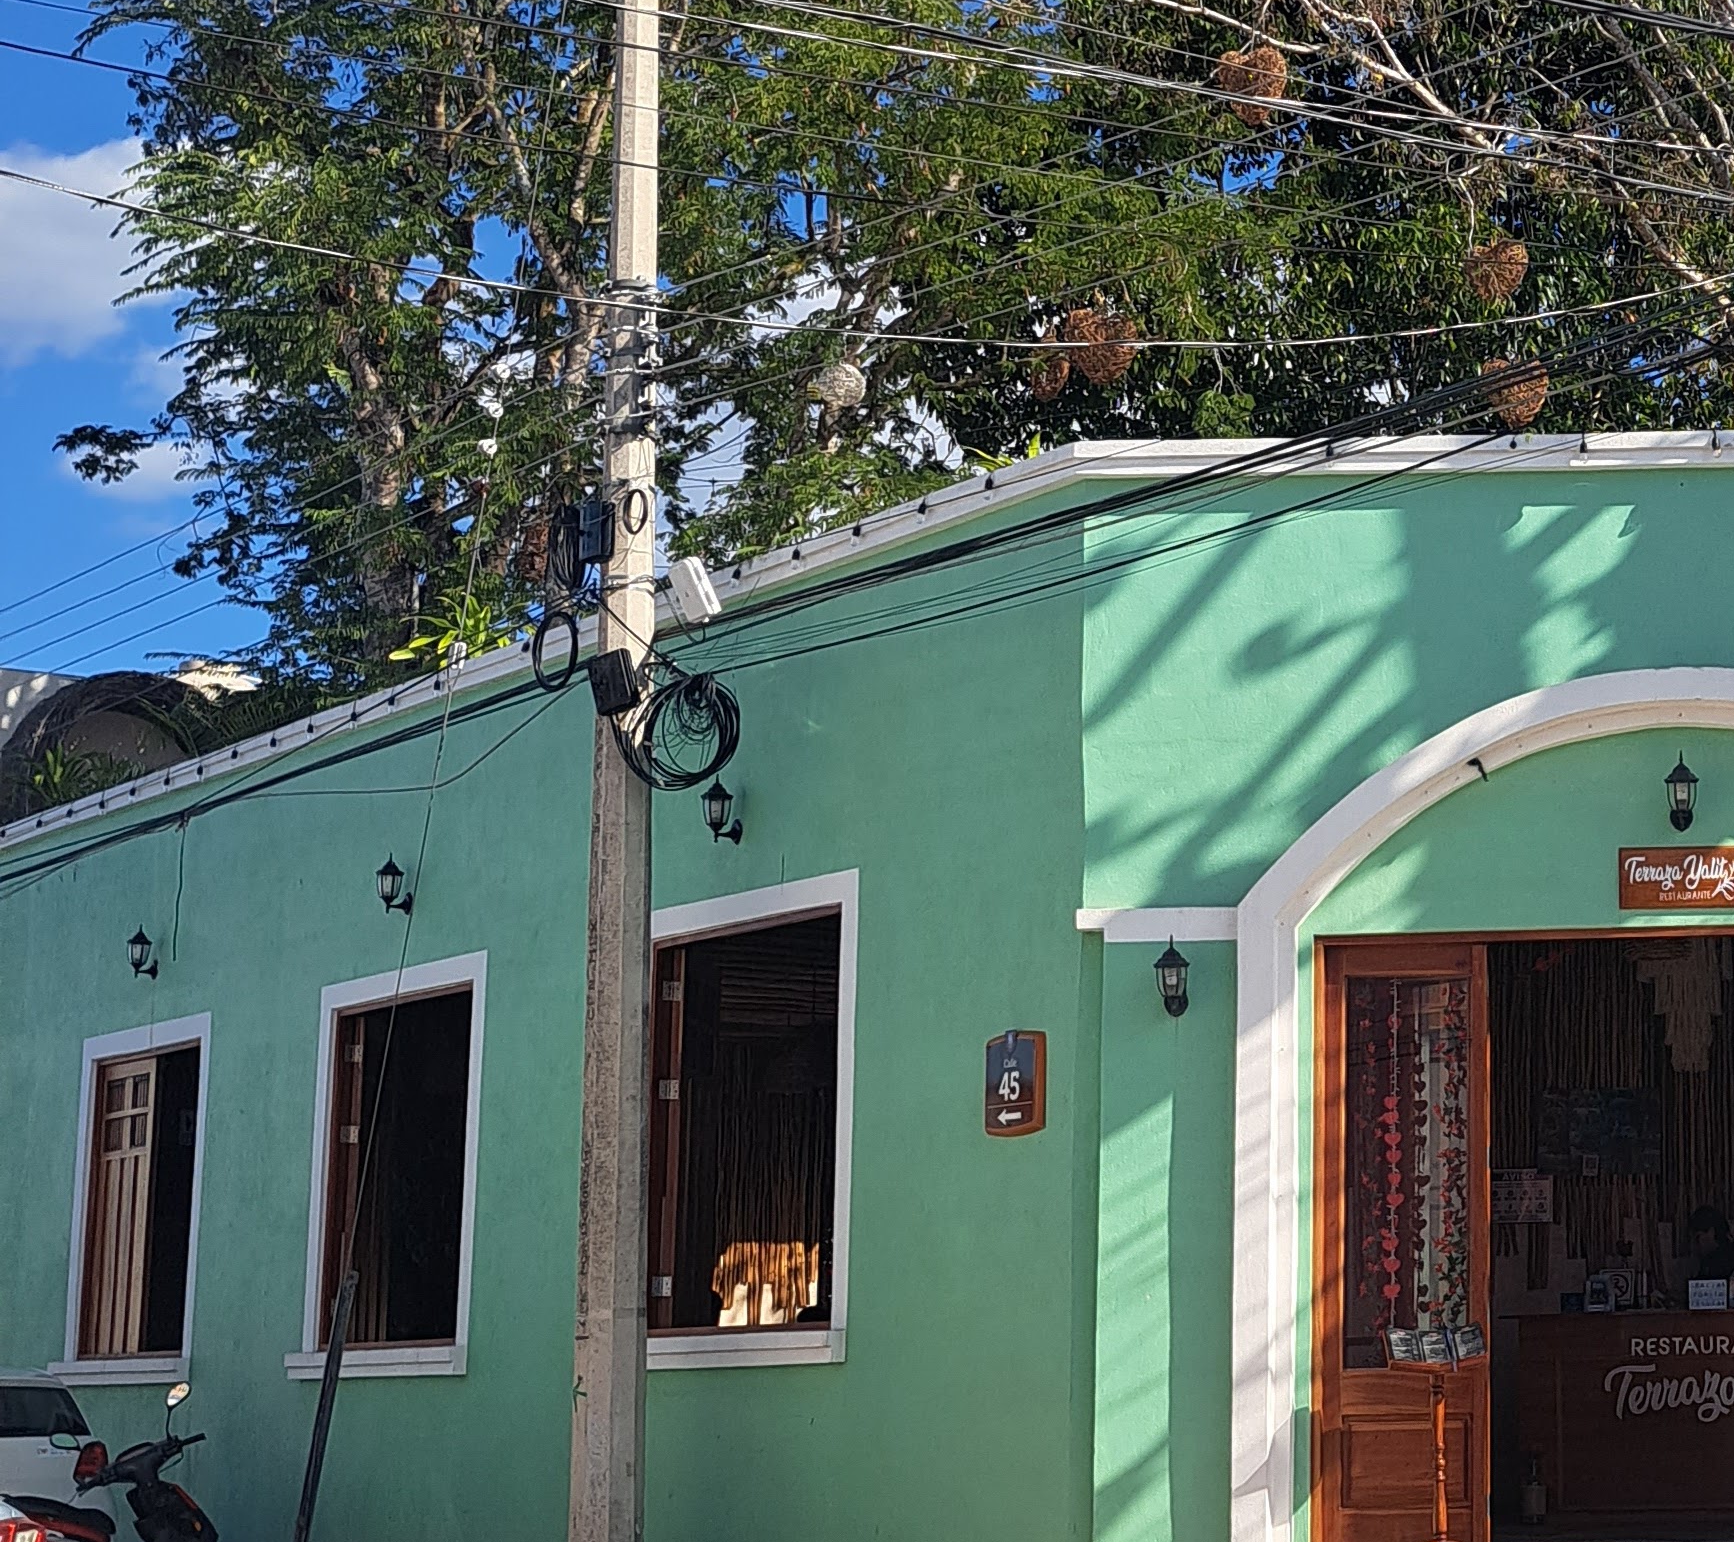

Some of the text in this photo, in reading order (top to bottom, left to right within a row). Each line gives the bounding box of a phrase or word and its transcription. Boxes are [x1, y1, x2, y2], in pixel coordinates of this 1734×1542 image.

[1625, 854, 1729, 891] Terraza Yalit
[1659, 890, 1712, 901] RESTAURANTE
[998, 1070, 1020, 1102] 45
